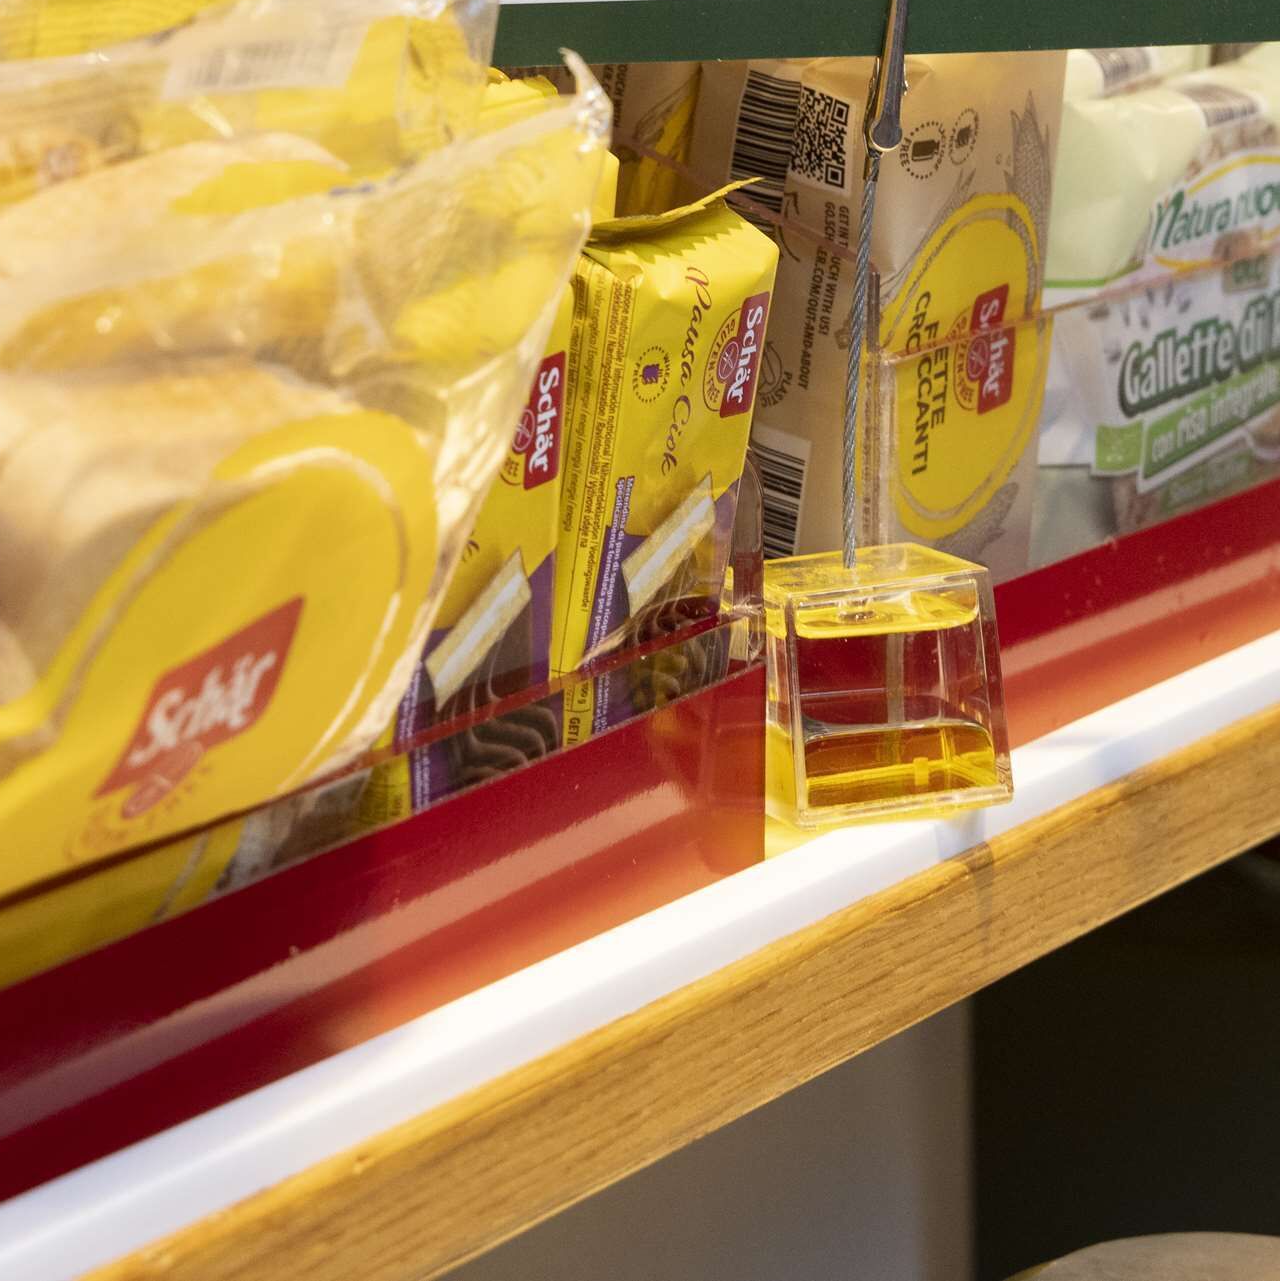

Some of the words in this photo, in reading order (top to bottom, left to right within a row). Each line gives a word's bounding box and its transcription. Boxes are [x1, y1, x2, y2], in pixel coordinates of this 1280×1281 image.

[899, 137, 912, 167] FREE
[838, 205, 849, 223] GET
[822, 282, 837, 313] WITH
[684, 266, 713, 388] Pausa
[818, 314, 831, 335] US!
[727, 304, 764, 404] Schär
[979, 297, 1002, 401] Schär
[1123, 324, 1235, 405] Gallette
[1239, 301, 1268, 363] di
[632, 362, 641, 391] FREE
[660, 352, 671, 392] WHEAT
[761, 371, 793, 408] PLASTIC
[925, 320, 949, 425] FETTE
[528, 366, 560, 474] Schär
[619, 477, 633, 528] Merendina
[612, 541, 622, 560] pan
[617, 529, 625, 540] di
[611, 560, 619, 571] di
[603, 572, 617, 606] spagna
[126, 651, 276, 767] Schär
[568, 716, 581, 736] GET
